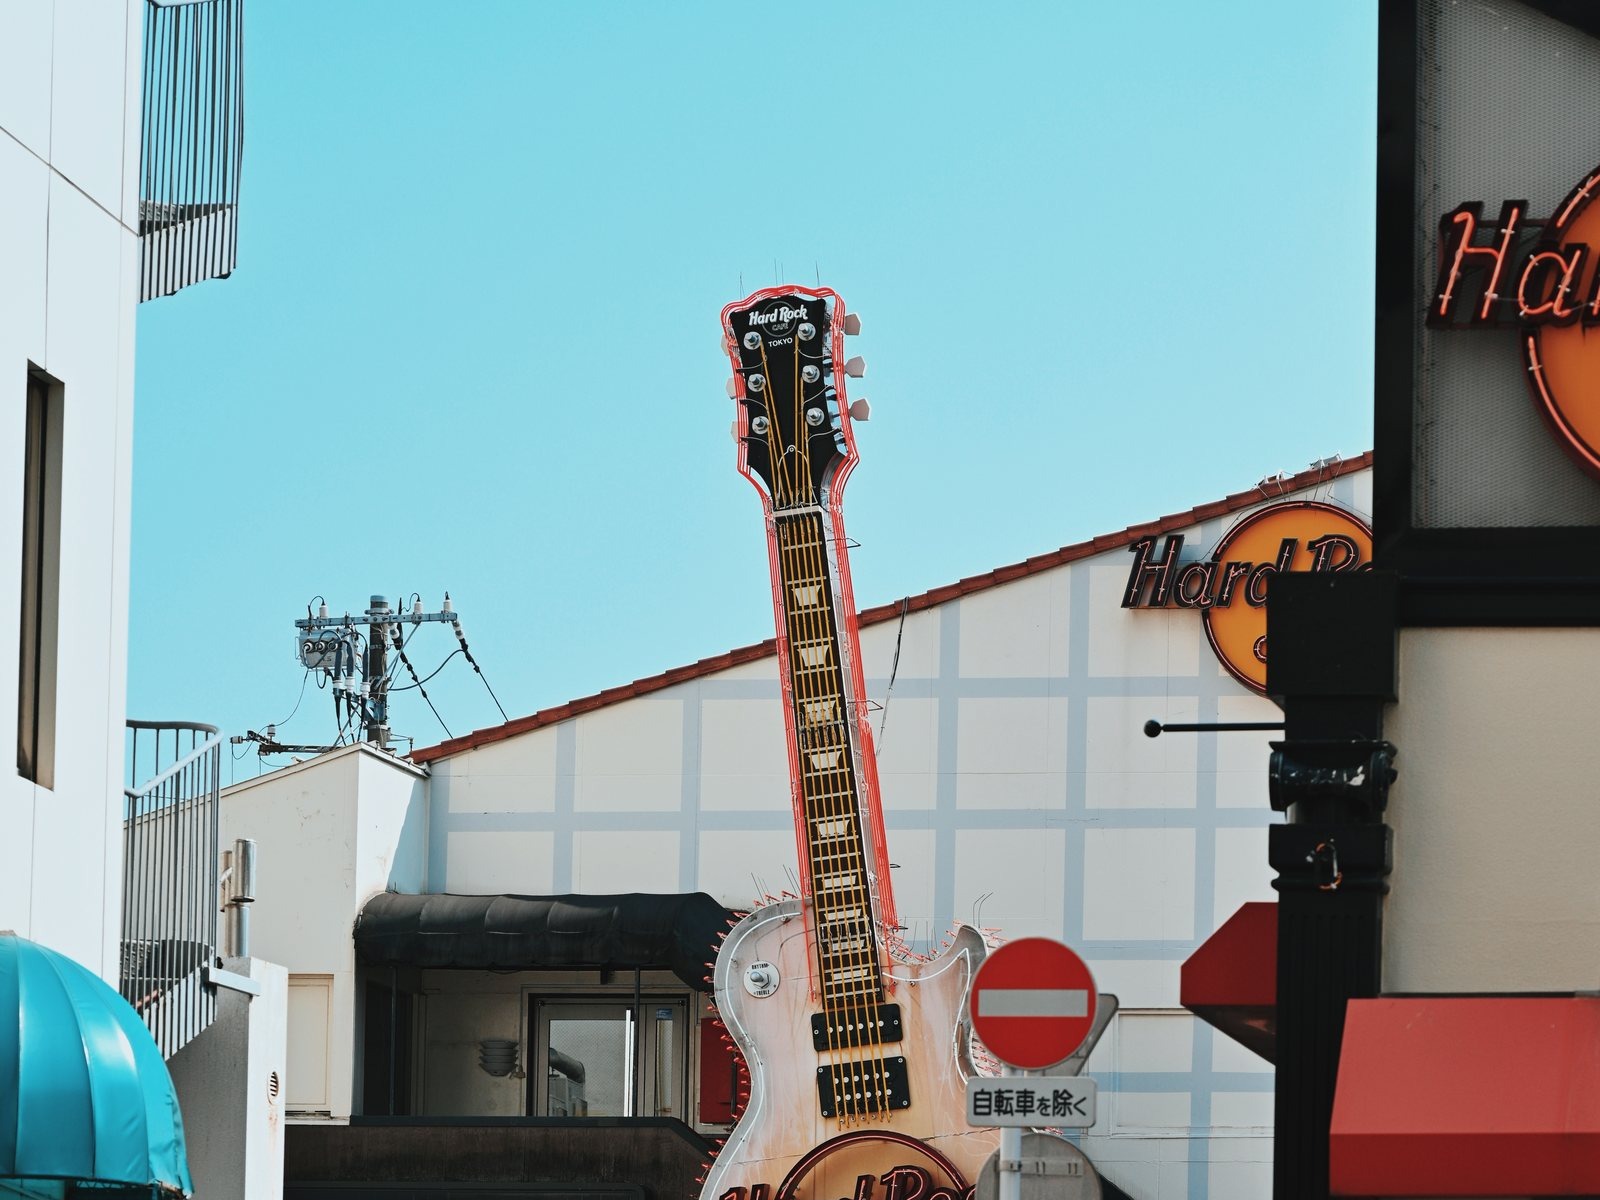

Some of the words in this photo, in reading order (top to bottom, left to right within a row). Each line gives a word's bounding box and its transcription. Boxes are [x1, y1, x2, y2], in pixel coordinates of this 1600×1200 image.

[749, 309, 779, 326] Hard
[779, 304, 809, 323] Rock
[768, 337, 793, 347] TOKYO
[973, 1088, 1087, 1117] 自転車を除く
